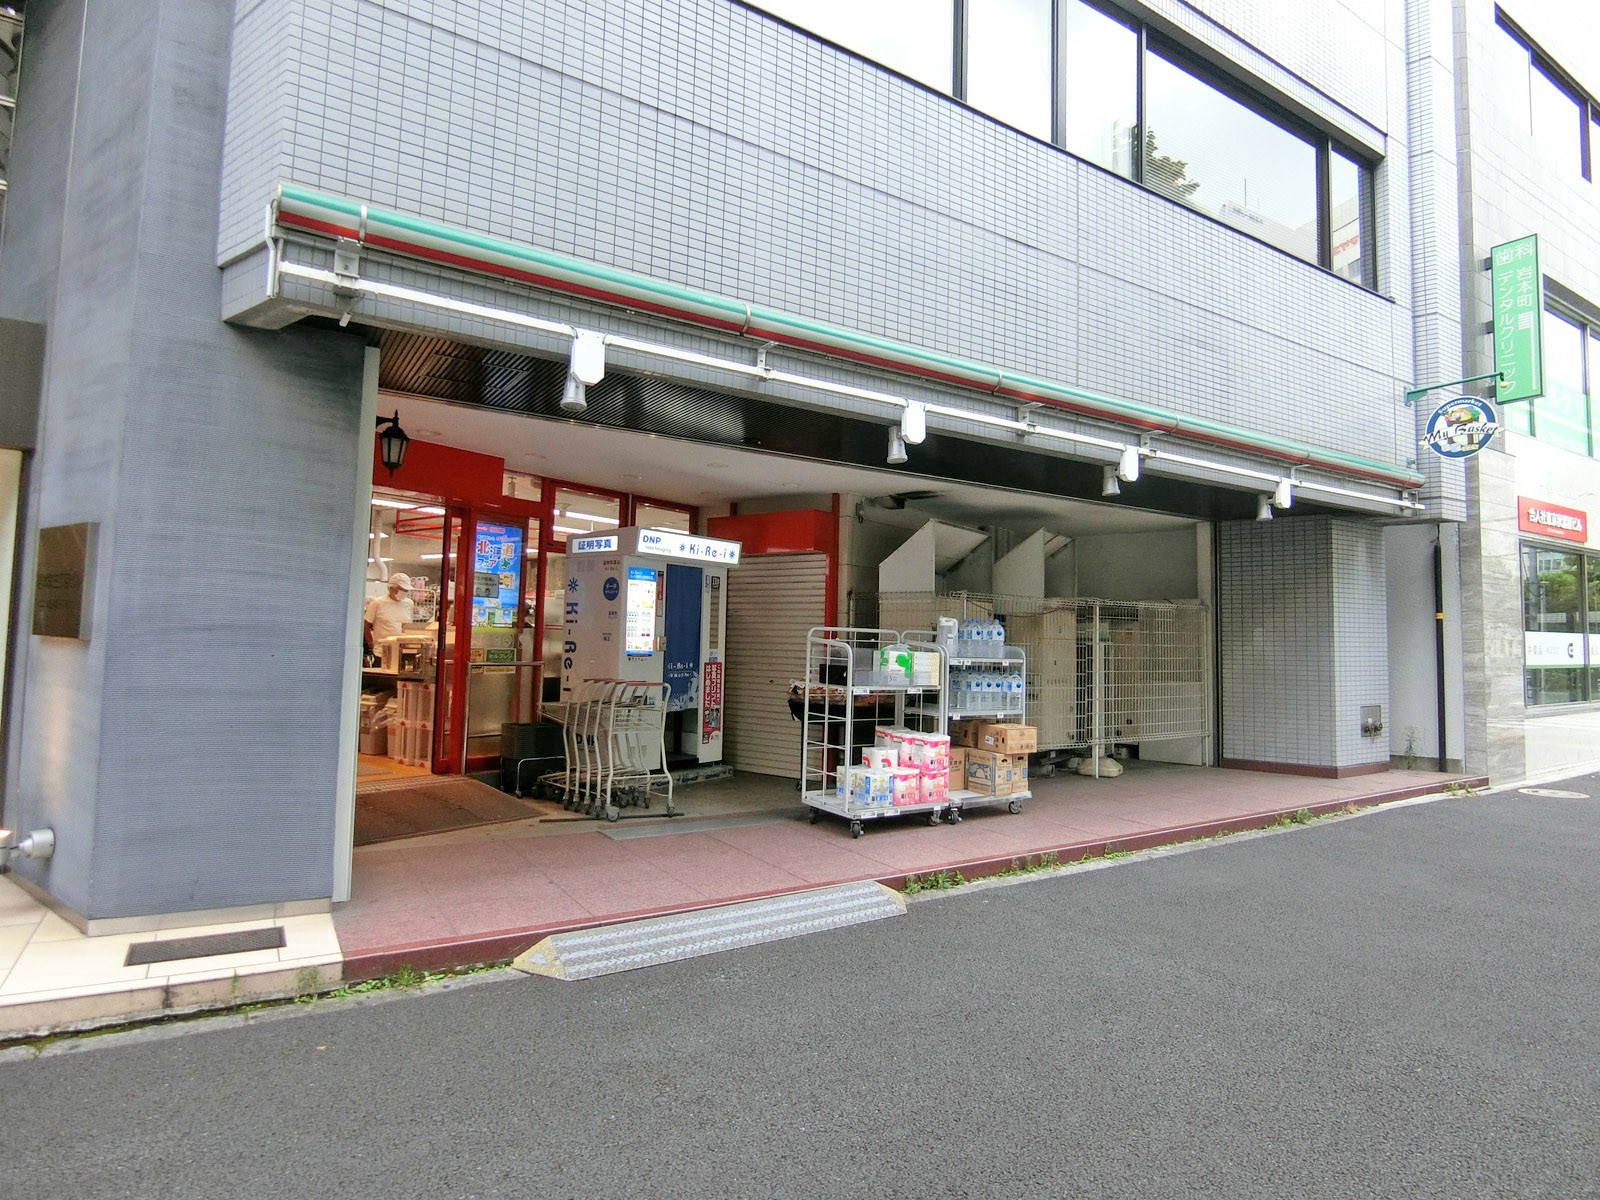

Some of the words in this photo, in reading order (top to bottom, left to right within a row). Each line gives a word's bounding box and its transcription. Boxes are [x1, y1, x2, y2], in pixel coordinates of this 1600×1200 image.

[1496, 242, 1534, 266] 歯科
[1516, 265, 1533, 307] 岩本町
[1498, 270, 1516, 395] デンタルクリニック
[1438, 399, 1482, 414] Supermarket
[1423, 430, 1449, 445] My
[1455, 422, 1498, 435] Basket
[578, 539, 612, 550] 証明写真
[642, 535, 662, 544] DNP
[477, 540, 514, 559] 北海道
[689, 543, 727, 558] Ki-Re-i
[478, 558, 496, 568] フェア
